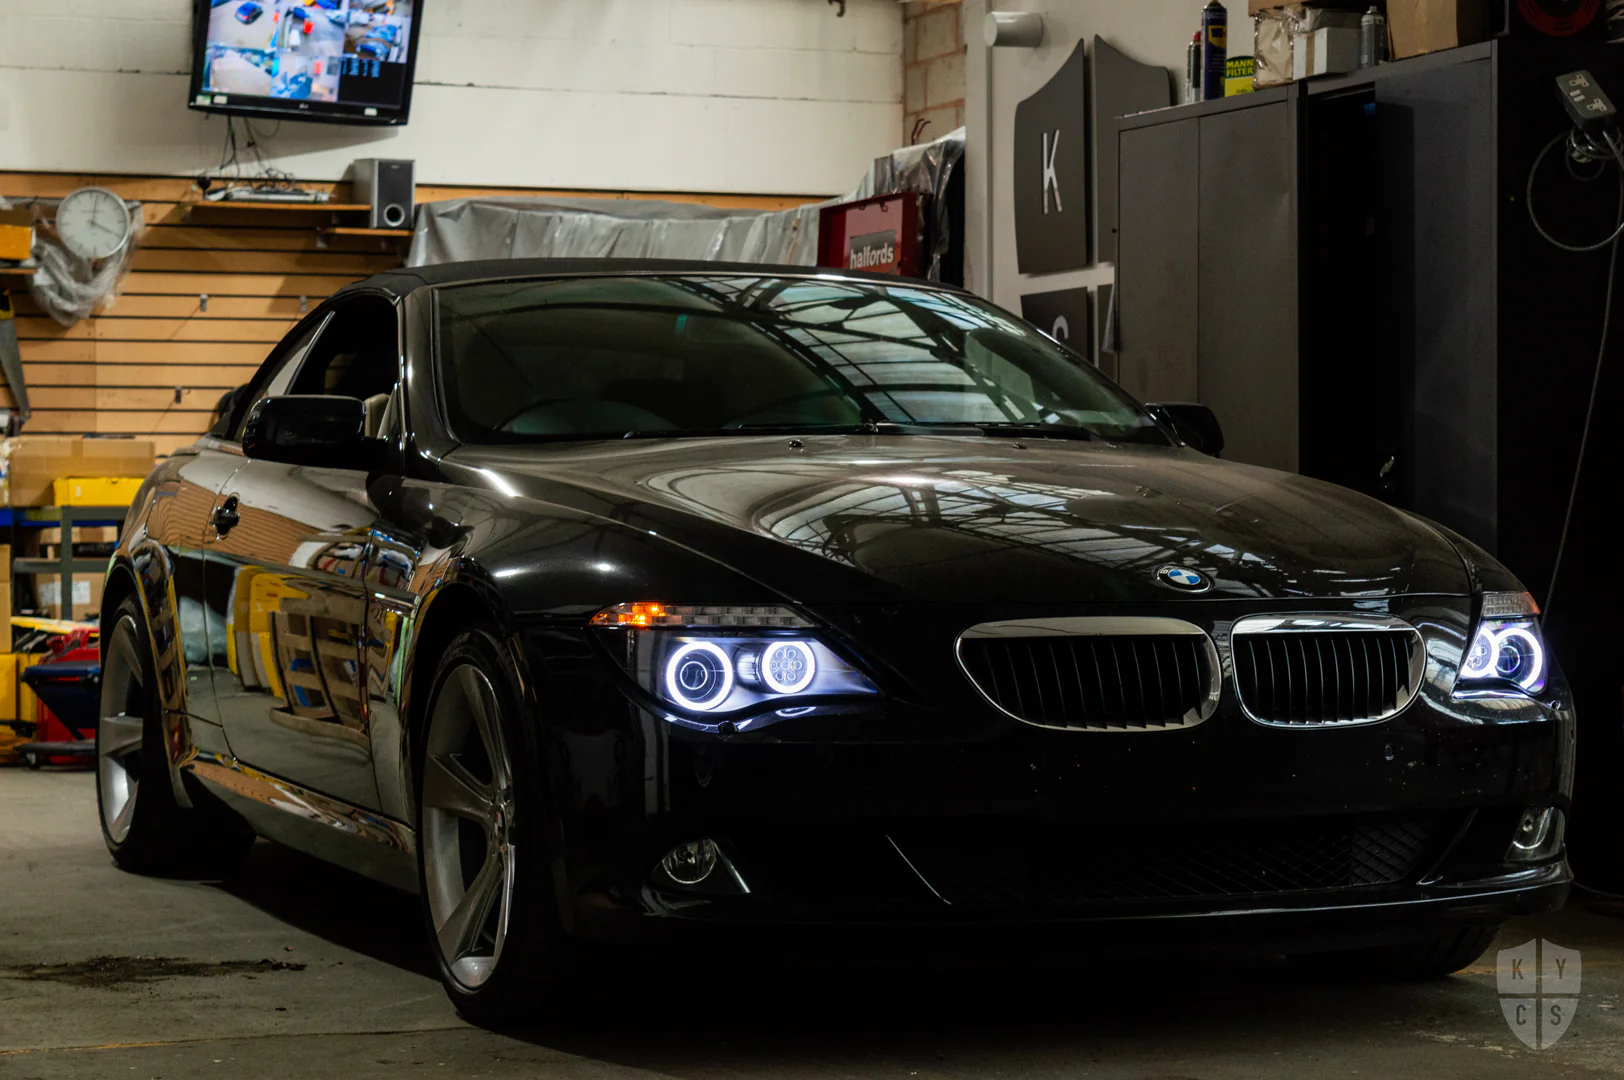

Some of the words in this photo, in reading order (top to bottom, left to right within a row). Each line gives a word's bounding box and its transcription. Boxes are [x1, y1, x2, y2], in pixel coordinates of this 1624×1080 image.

[1226, 59, 1254, 69] MANN
[1226, 67, 1254, 77] FILTER
[1043, 129, 1063, 214] K
[850, 242, 894, 270] halfords
